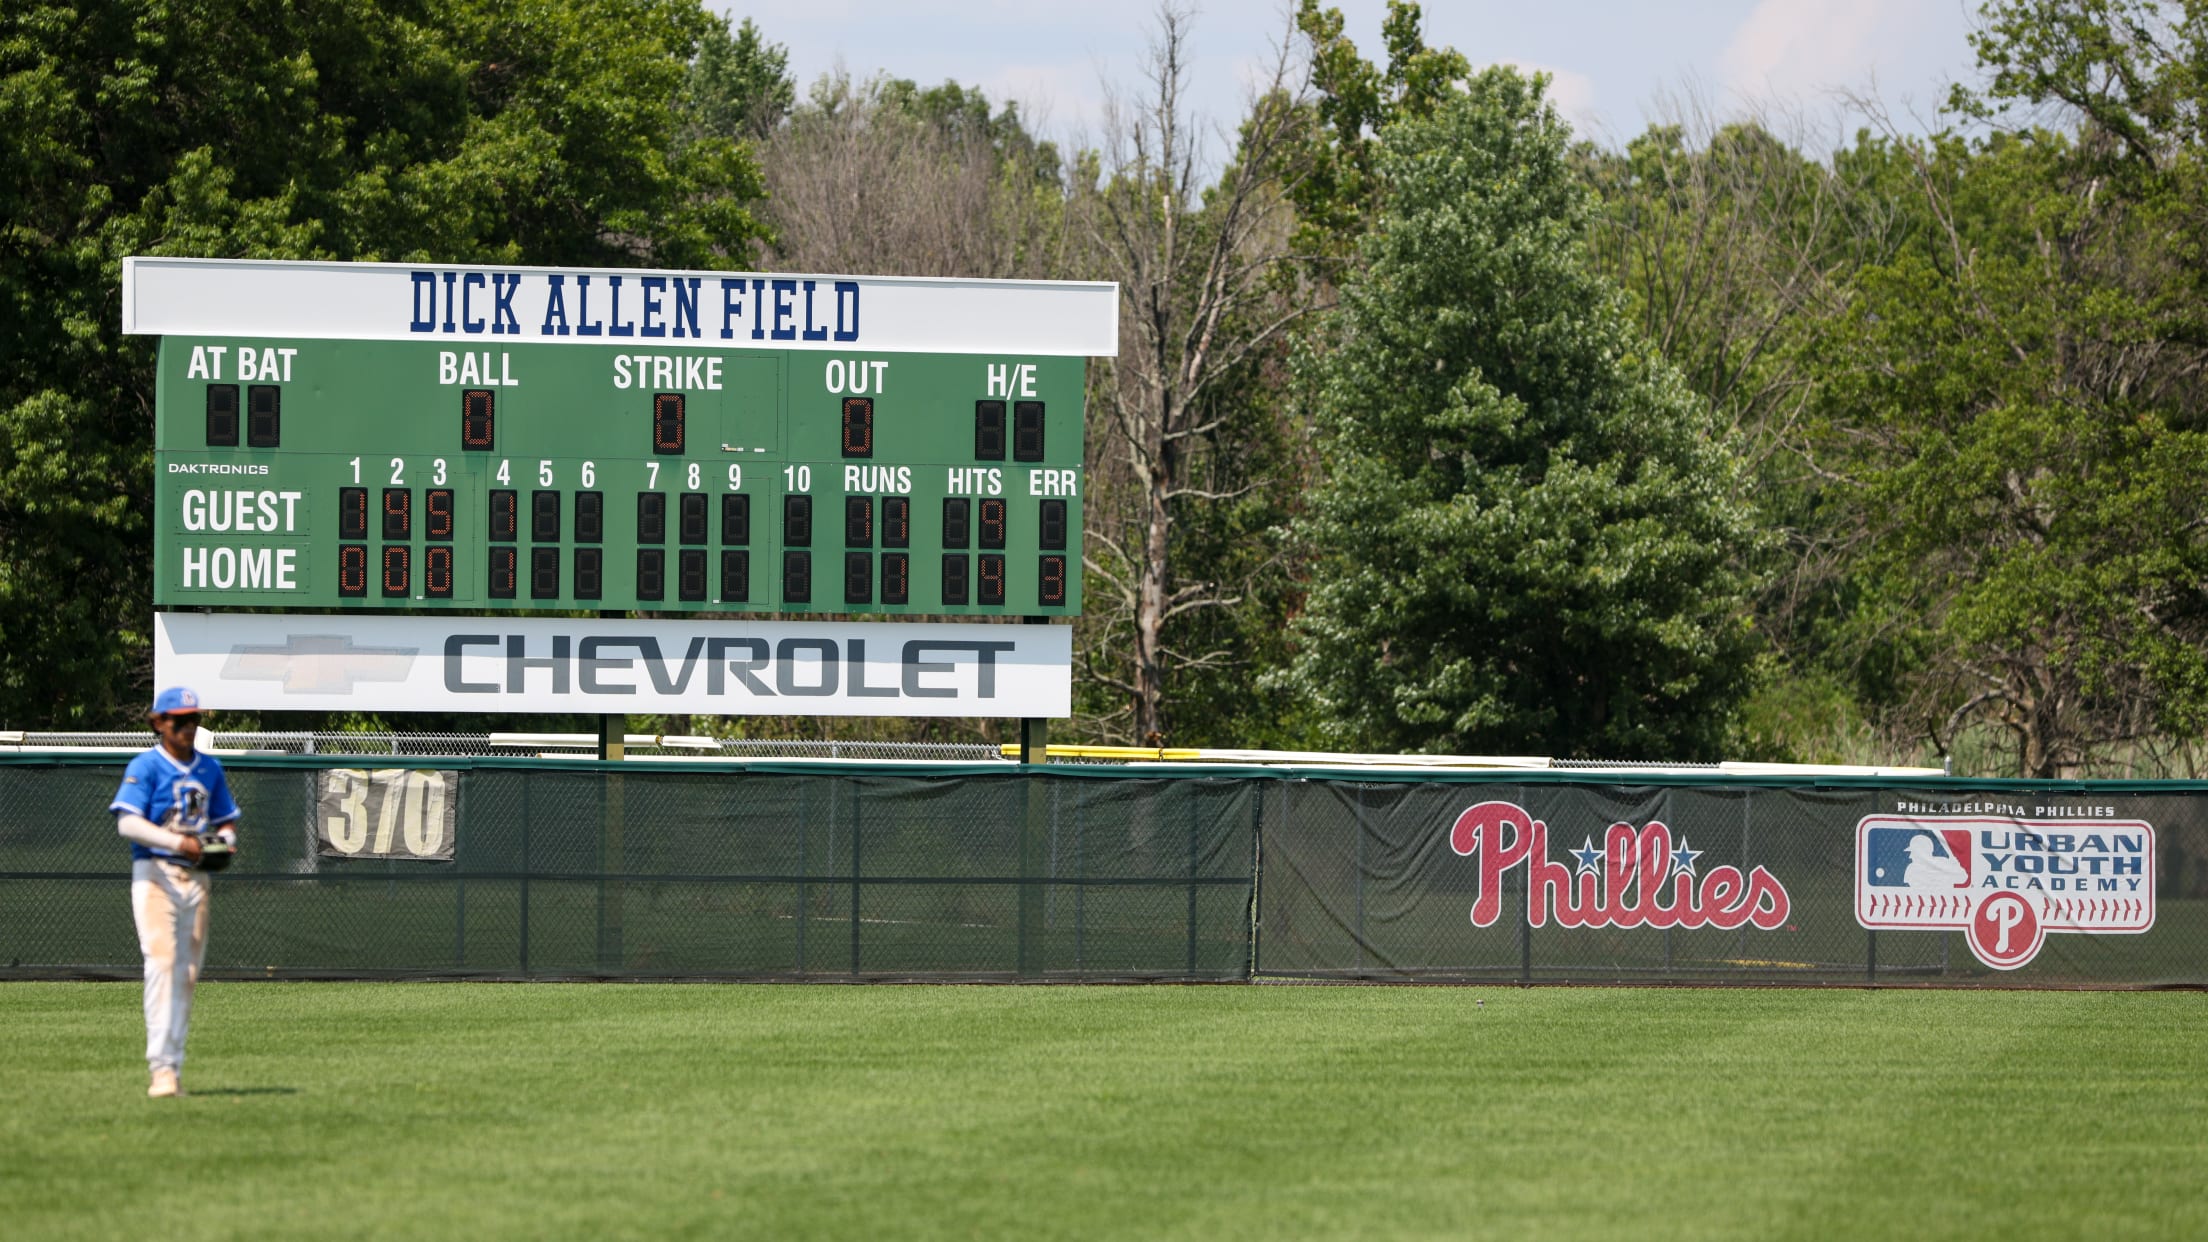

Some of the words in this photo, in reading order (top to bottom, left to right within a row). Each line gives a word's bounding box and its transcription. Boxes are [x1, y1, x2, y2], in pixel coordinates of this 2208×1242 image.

[410, 271, 521, 335] DICK
[541, 274, 701, 338] ALLEN
[720, 277, 860, 342] FIELD
[187, 345, 227, 380] AT
[238, 346, 298, 382] BAT
[439, 351, 519, 386] BALL
[613, 354, 723, 390] STRIKE
[825, 359, 889, 394] OUT
[987, 363, 1037, 400] H/E
[464, 391, 492, 446] 0
[656, 394, 683, 449] 0
[844, 398, 871, 453] 0
[168, 463, 269, 475] DAKTRONICS
[349, 457, 360, 484] 1
[390, 457, 404, 485] 2
[432, 458, 447, 486] 3
[496, 459, 511, 486] 4
[539, 460, 553, 487] 5
[581, 461, 595, 488] 6
[646, 462, 660, 489] 7
[687, 463, 701, 490] 8
[728, 464, 741, 490] 9
[783, 465, 811, 493] 10
[844, 465, 912, 494] RUNS
[948, 467, 1002, 495] HITS
[1029, 469, 1077, 497] ERR
[182, 489, 302, 532] GUEST
[385, 493, 409, 531] 4
[428, 491, 451, 535] 5
[982, 501, 1003, 540] 9
[183, 547, 297, 589] HOME
[341, 547, 365, 591] 0
[384, 547, 408, 591] 0
[427, 548, 451, 592] 0
[982, 559, 1002, 596] 4
[1044, 557, 1063, 600] 3
[443, 634, 1016, 699] CHEVROLET
[327, 768, 446, 856] 370
[1896, 801, 2026, 816] PHILADELPHIA
[2035, 806, 2115, 817] PHILLIES
[1981, 830, 2143, 853] URBAN
[1450, 801, 1791, 930] Phillies
[1982, 853, 2142, 875] YOUTH
[1982, 875, 2141, 892] ACADEMY
[1985, 897, 2024, 953] P
